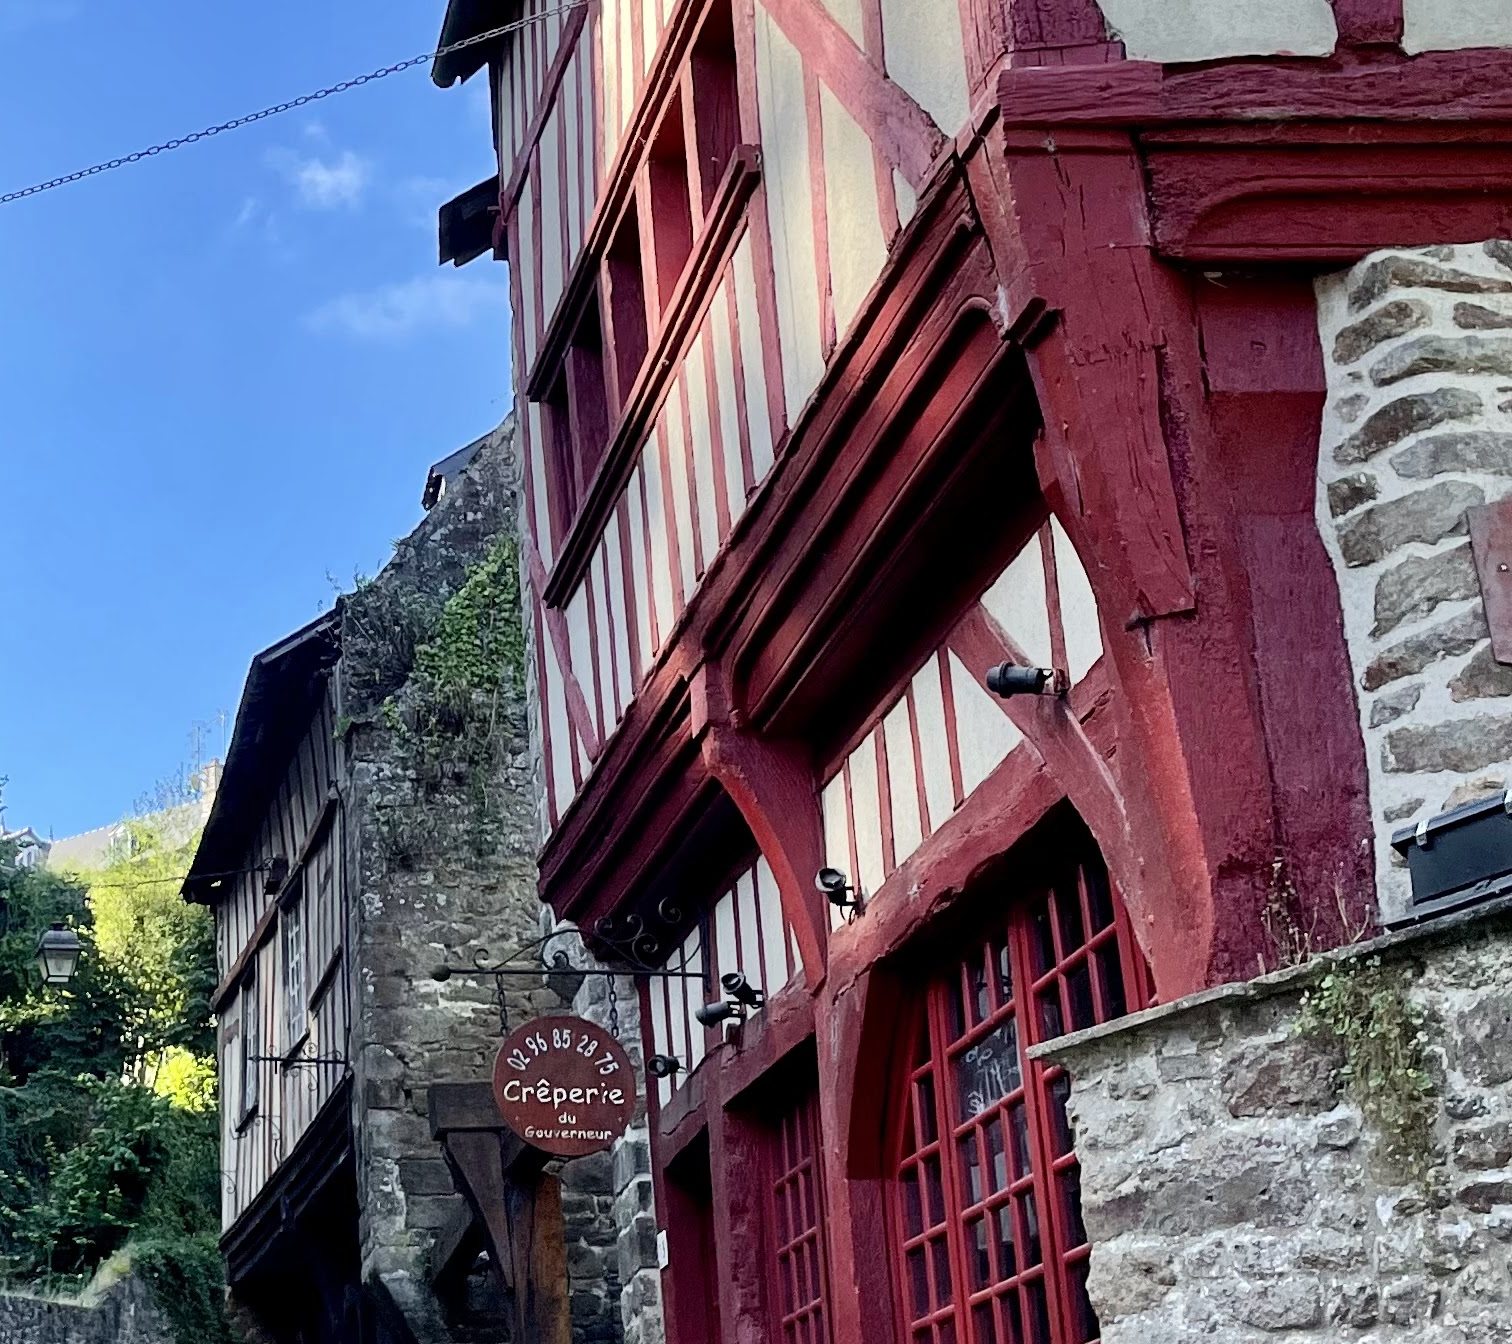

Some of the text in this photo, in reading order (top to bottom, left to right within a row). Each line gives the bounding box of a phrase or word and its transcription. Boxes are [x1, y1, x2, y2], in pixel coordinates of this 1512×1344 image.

[506, 1027, 620, 1075] 02 96 85 28 75
[503, 1078, 625, 1110] Crêperie
[557, 1112, 577, 1125] du
[524, 1125, 613, 1140] Gouverneur
